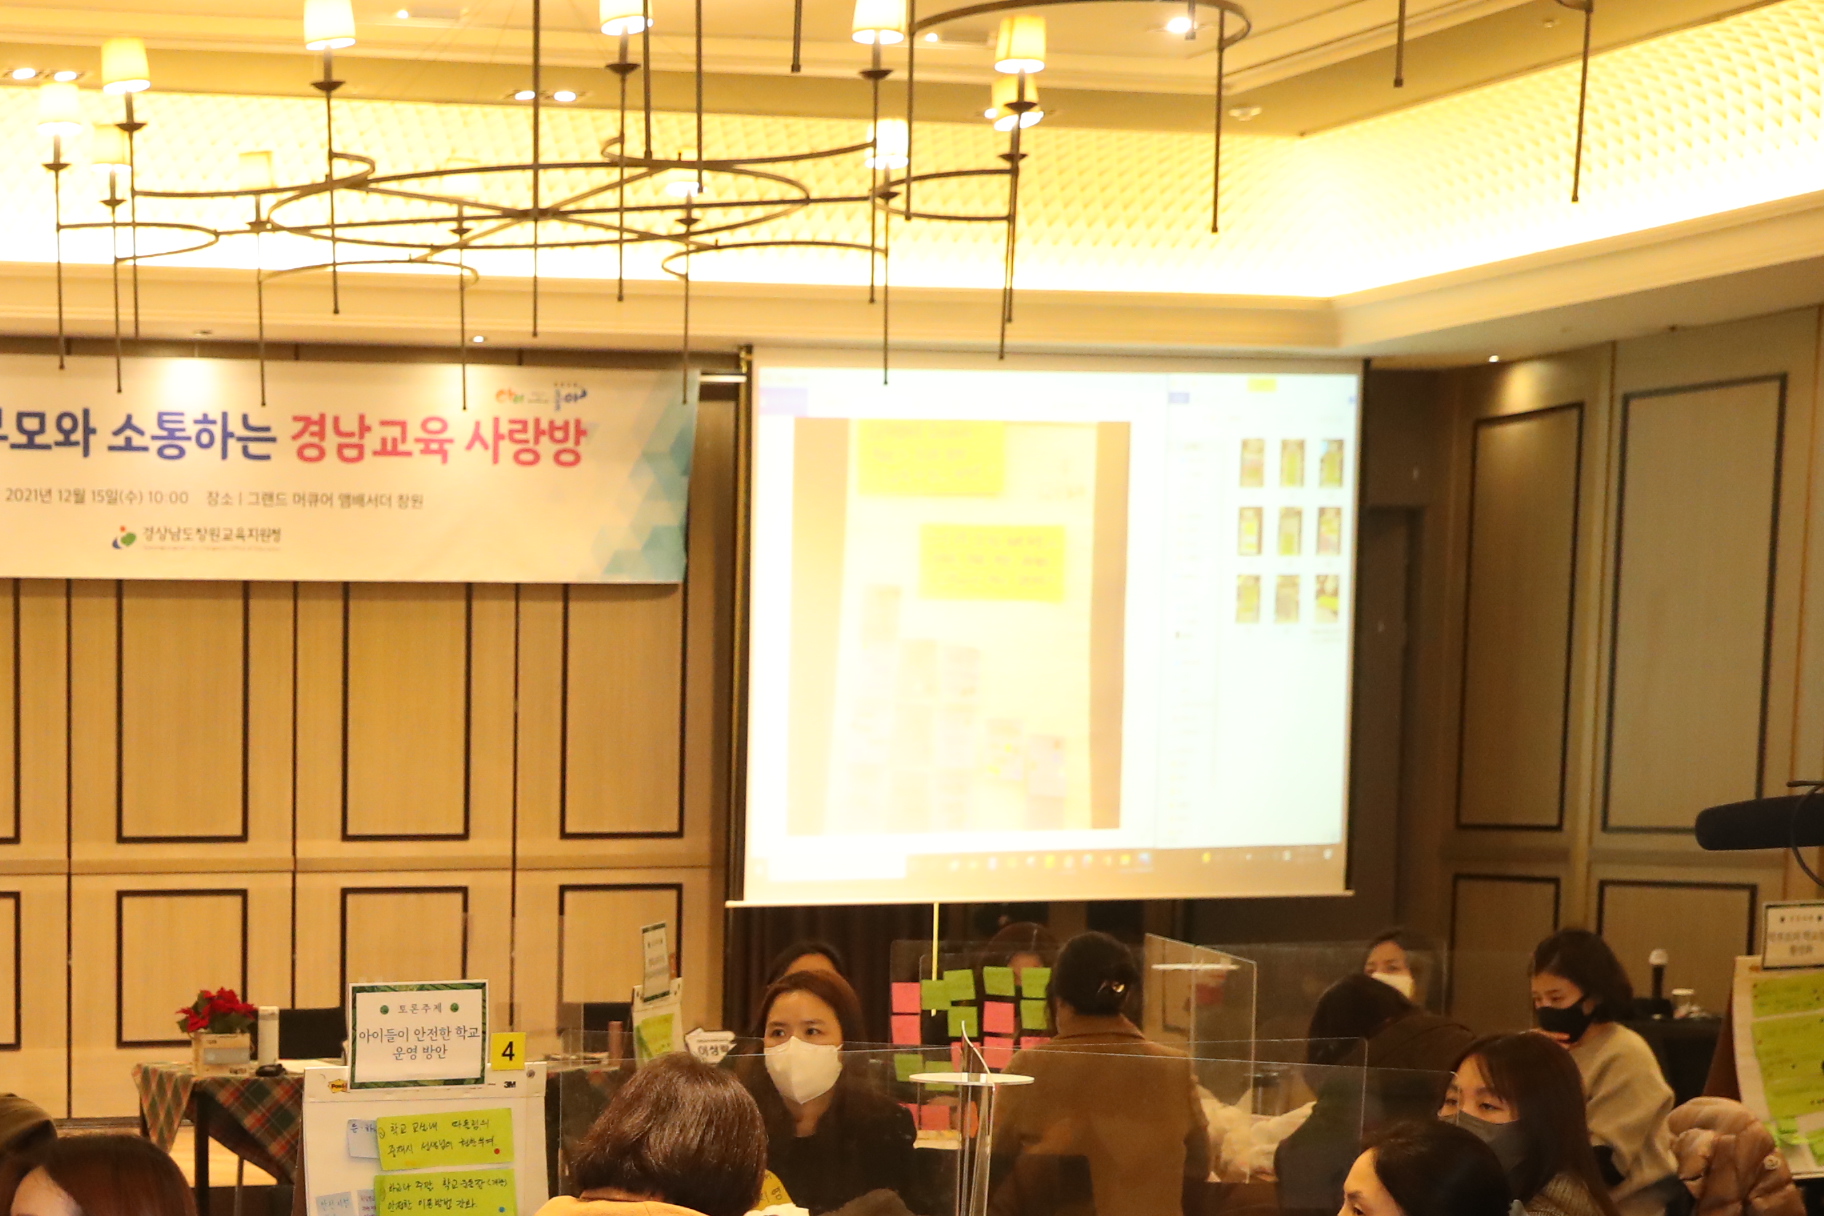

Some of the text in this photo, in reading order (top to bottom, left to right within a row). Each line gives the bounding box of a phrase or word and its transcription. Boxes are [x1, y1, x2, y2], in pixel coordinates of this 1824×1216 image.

[107, 411, 278, 461] 소통하는
[291, 413, 455, 465] 경남교육
[465, 416, 588, 468] 사랑방
[5, 488, 53, 504] 2021년
[57, 488, 86, 504] 12월
[91, 489, 143, 505] 15일(수)
[206, 491, 233, 507] 장소
[248, 491, 288, 507] 그랜드
[397, 493, 424, 509] 창원
[398, 1002, 442, 1014] 토론주제
[359, 1025, 480, 1044] 아이들이 안전한 학교
[393, 1044, 448, 1061] 운영 방안
[501, 1041, 515, 1061] 4
[503, 1081, 516, 1089] 3M
[390, 1122, 407, 1136] 학교
